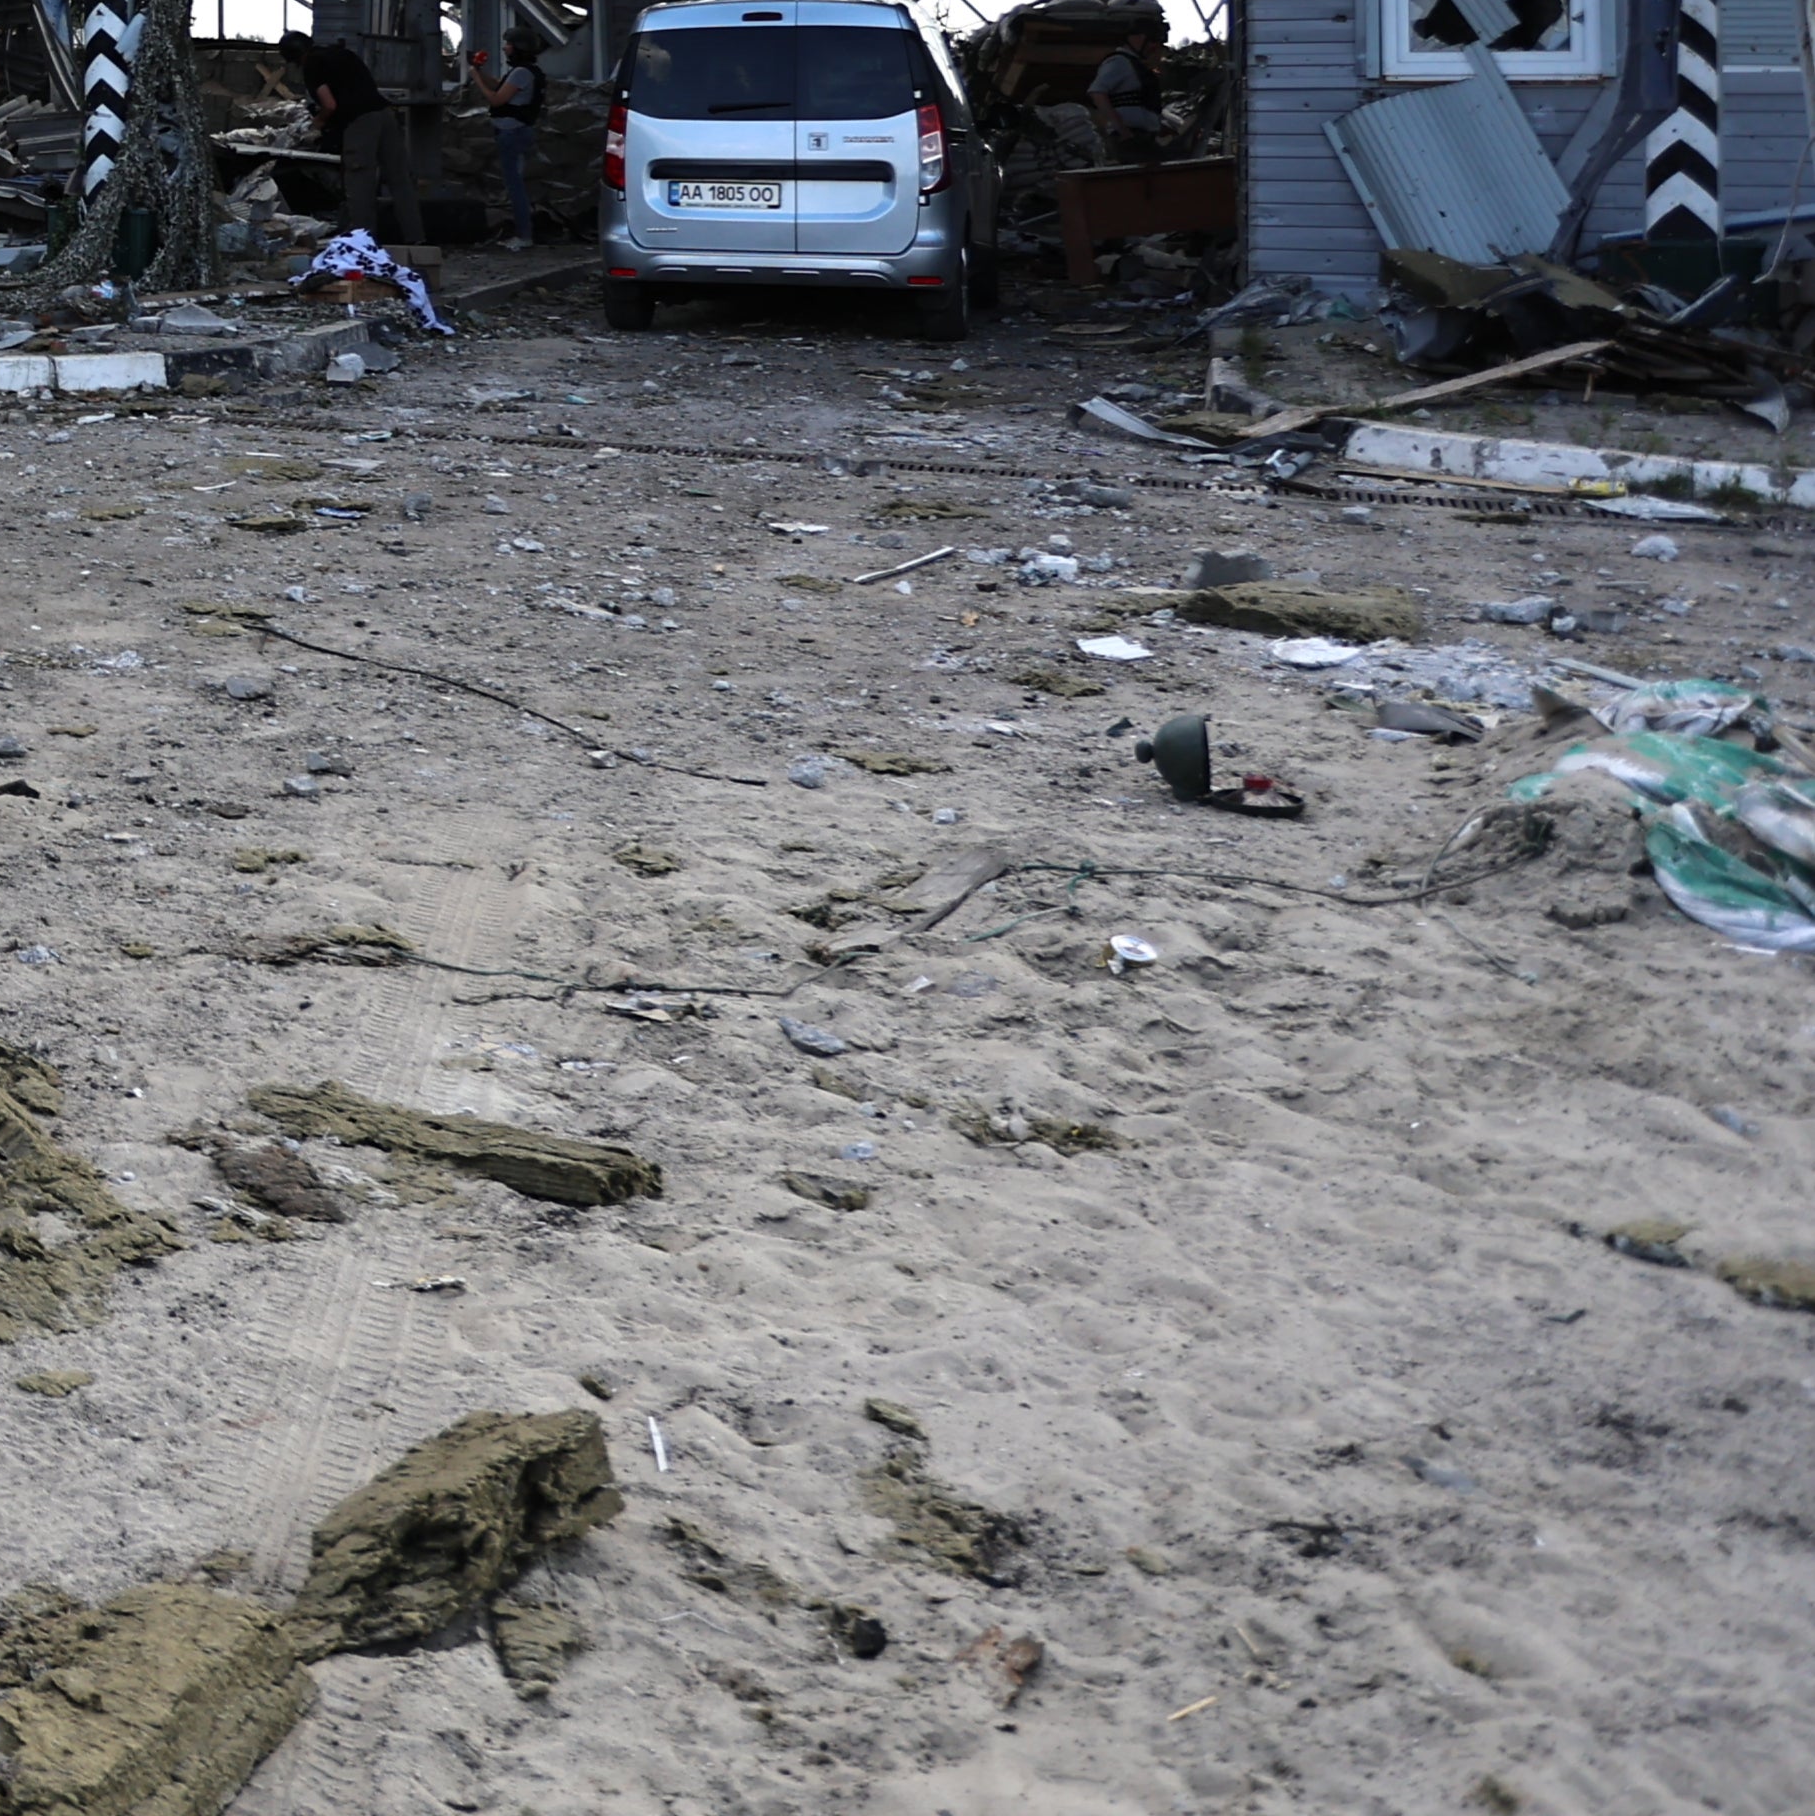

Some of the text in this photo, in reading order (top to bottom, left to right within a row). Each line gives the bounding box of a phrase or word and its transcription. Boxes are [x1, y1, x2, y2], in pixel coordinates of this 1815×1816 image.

[680, 185, 774, 202] AA 1805 OO
